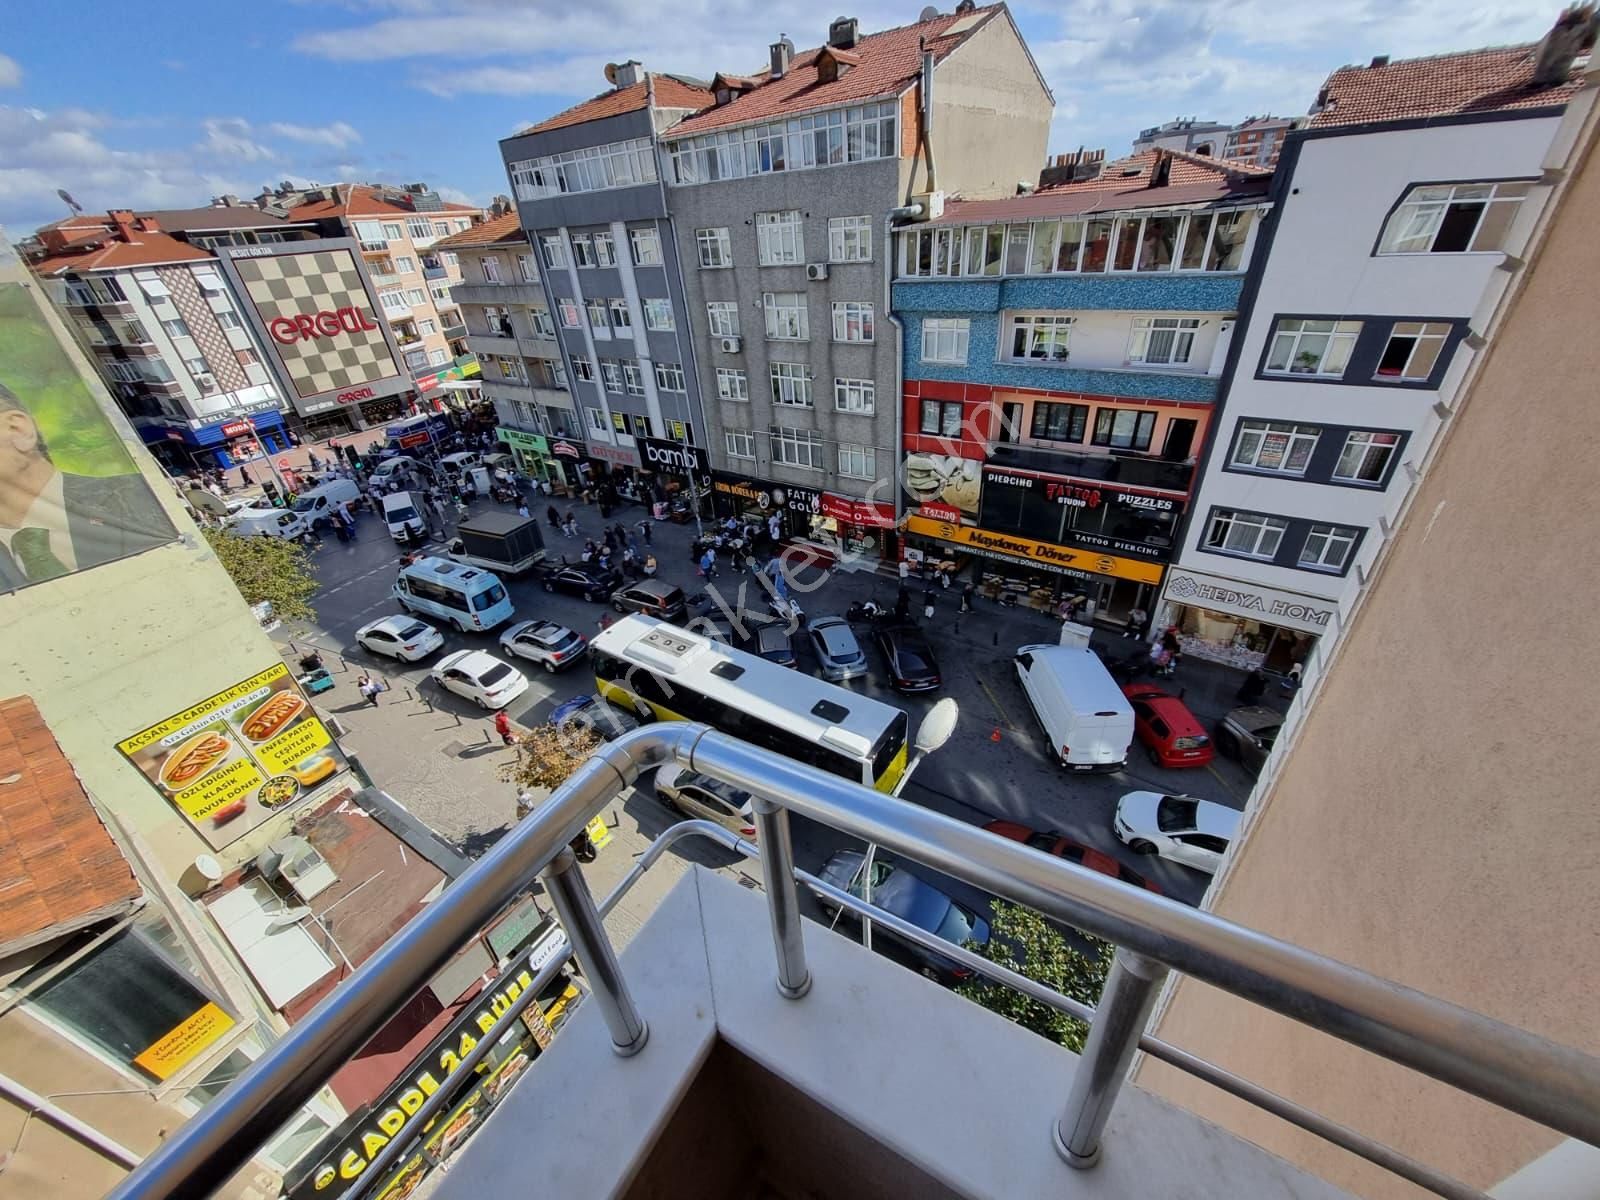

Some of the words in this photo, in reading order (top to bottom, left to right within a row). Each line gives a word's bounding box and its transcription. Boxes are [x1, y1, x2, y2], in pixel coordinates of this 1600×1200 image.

[645, 441, 699, 471] bambi
[1118, 493, 1173, 510] PUZZLES
[968, 530, 1032, 557] Maydonoz
[1035, 545, 1078, 564] Döner
[1074, 534, 1110, 547] TATTOO
[1115, 541, 1160, 557] PIERCING
[1197, 584, 1266, 612] HEDYA
[439, 1030, 478, 1075] 24
